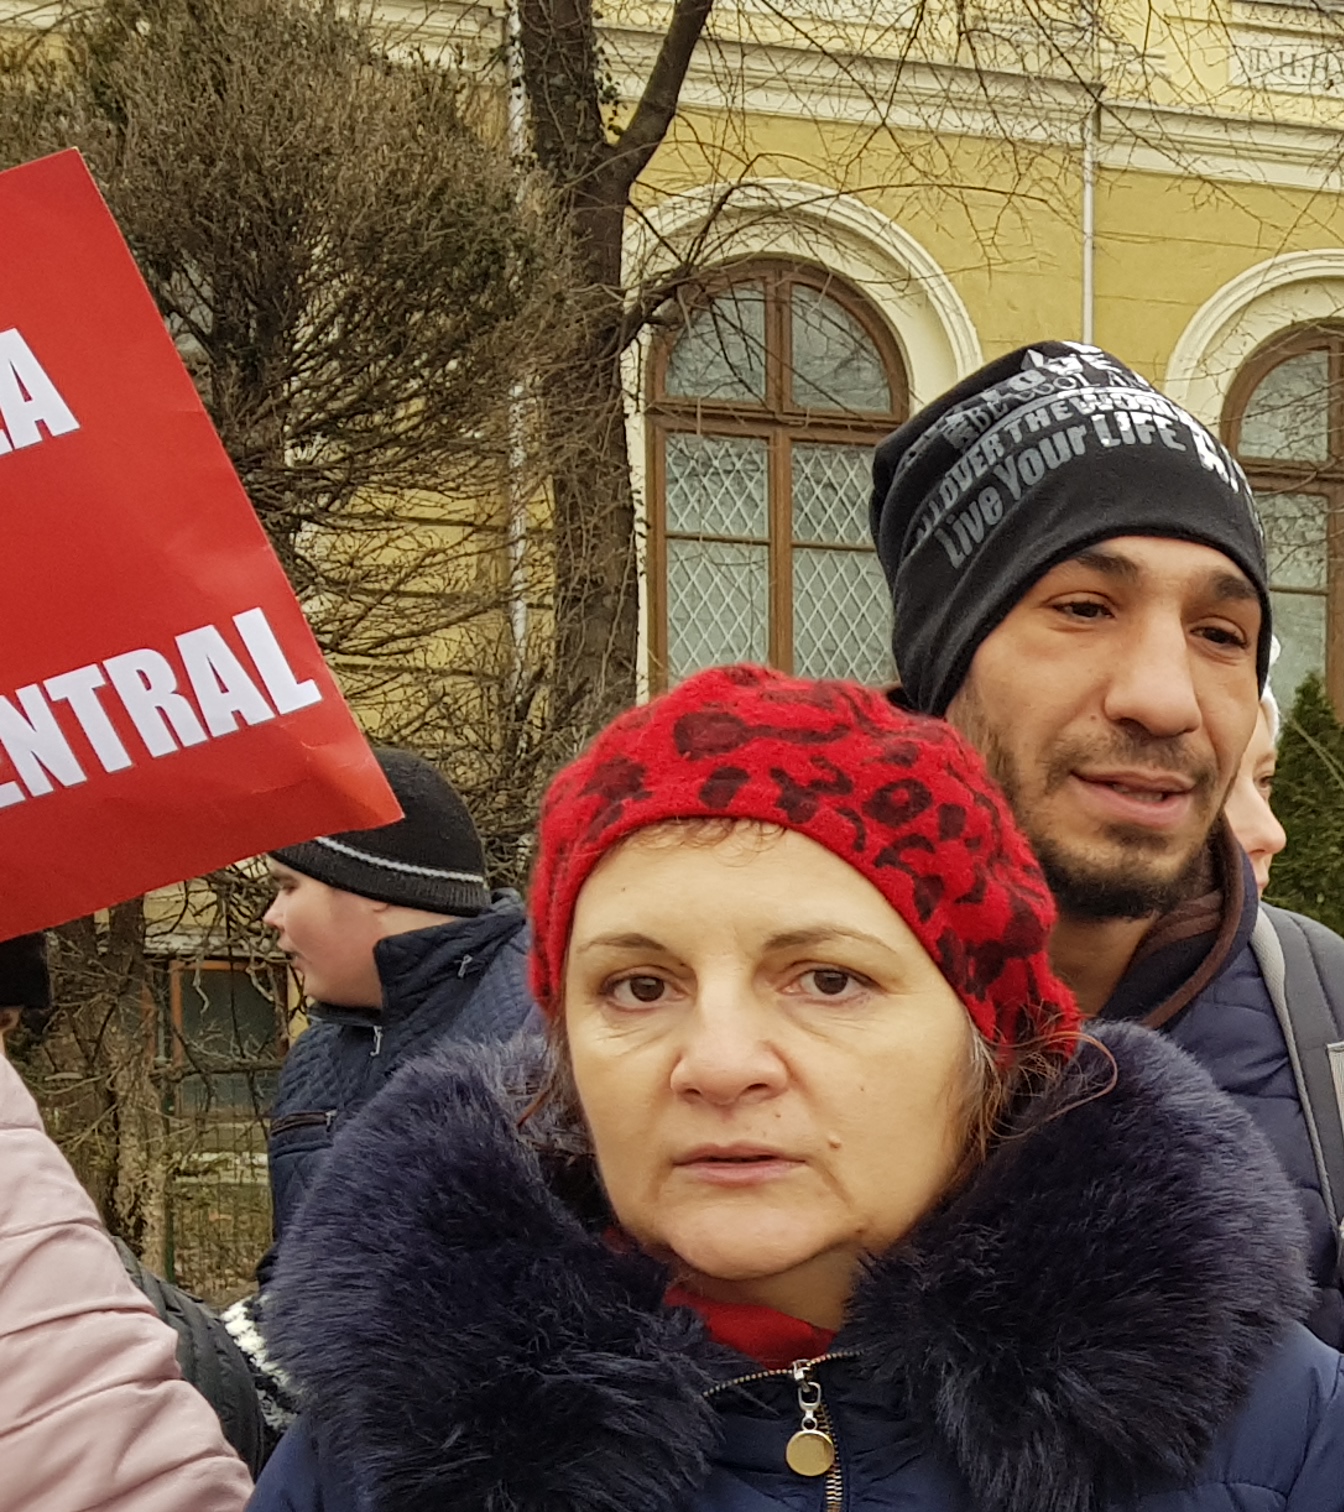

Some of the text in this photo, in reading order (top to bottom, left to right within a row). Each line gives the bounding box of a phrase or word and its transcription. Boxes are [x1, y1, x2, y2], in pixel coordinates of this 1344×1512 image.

[0, 327, 81, 455] A
[1091, 411, 1188, 452] LIFE
[938, 433, 1005, 510] OVER
[1003, 400, 1074, 444] THE
